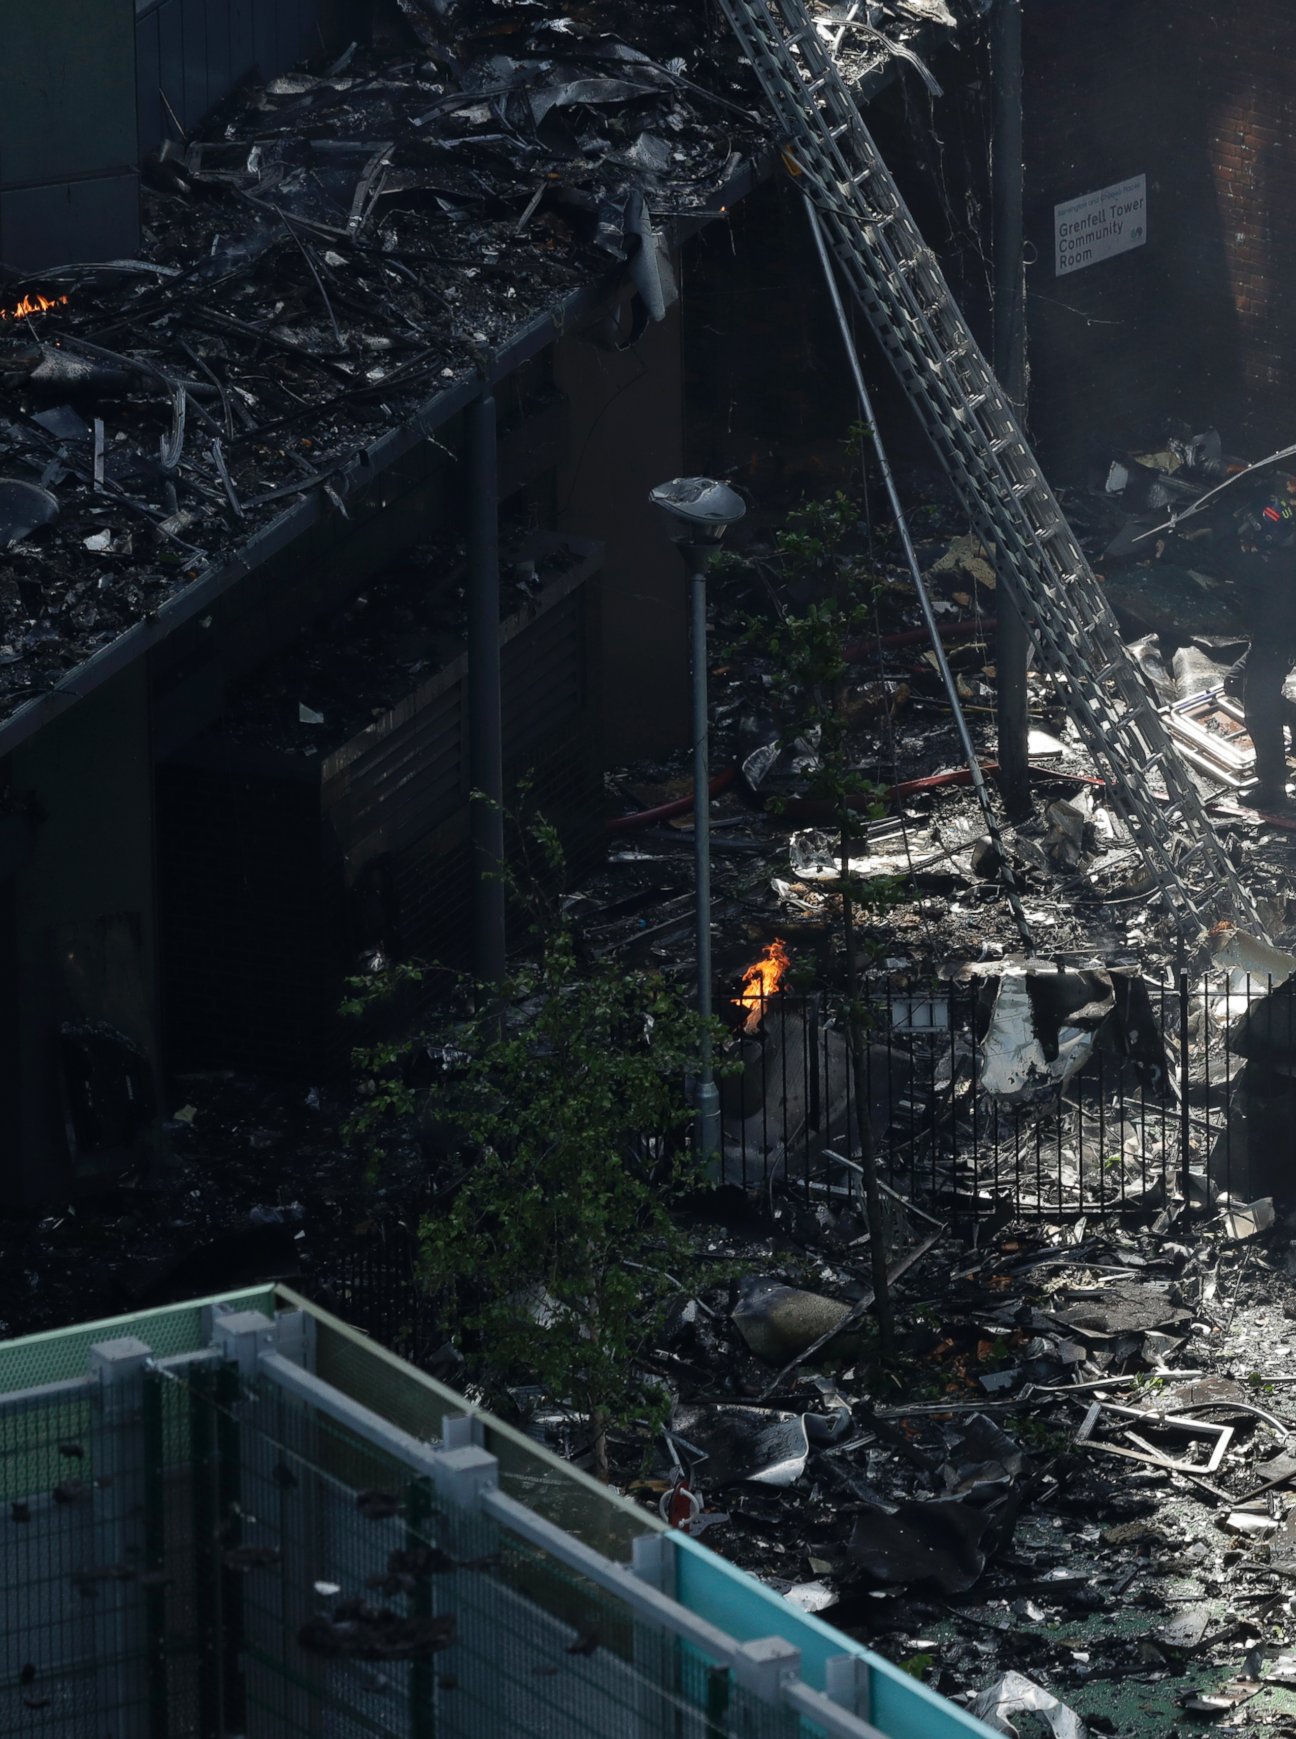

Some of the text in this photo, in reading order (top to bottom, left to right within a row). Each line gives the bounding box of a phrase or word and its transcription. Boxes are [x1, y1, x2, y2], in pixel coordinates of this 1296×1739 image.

[1059, 210, 1106, 237] Grenfell
[1110, 198, 1144, 218] Tower
[1059, 220, 1124, 253] Community
[1060, 248, 1093, 269] Room
